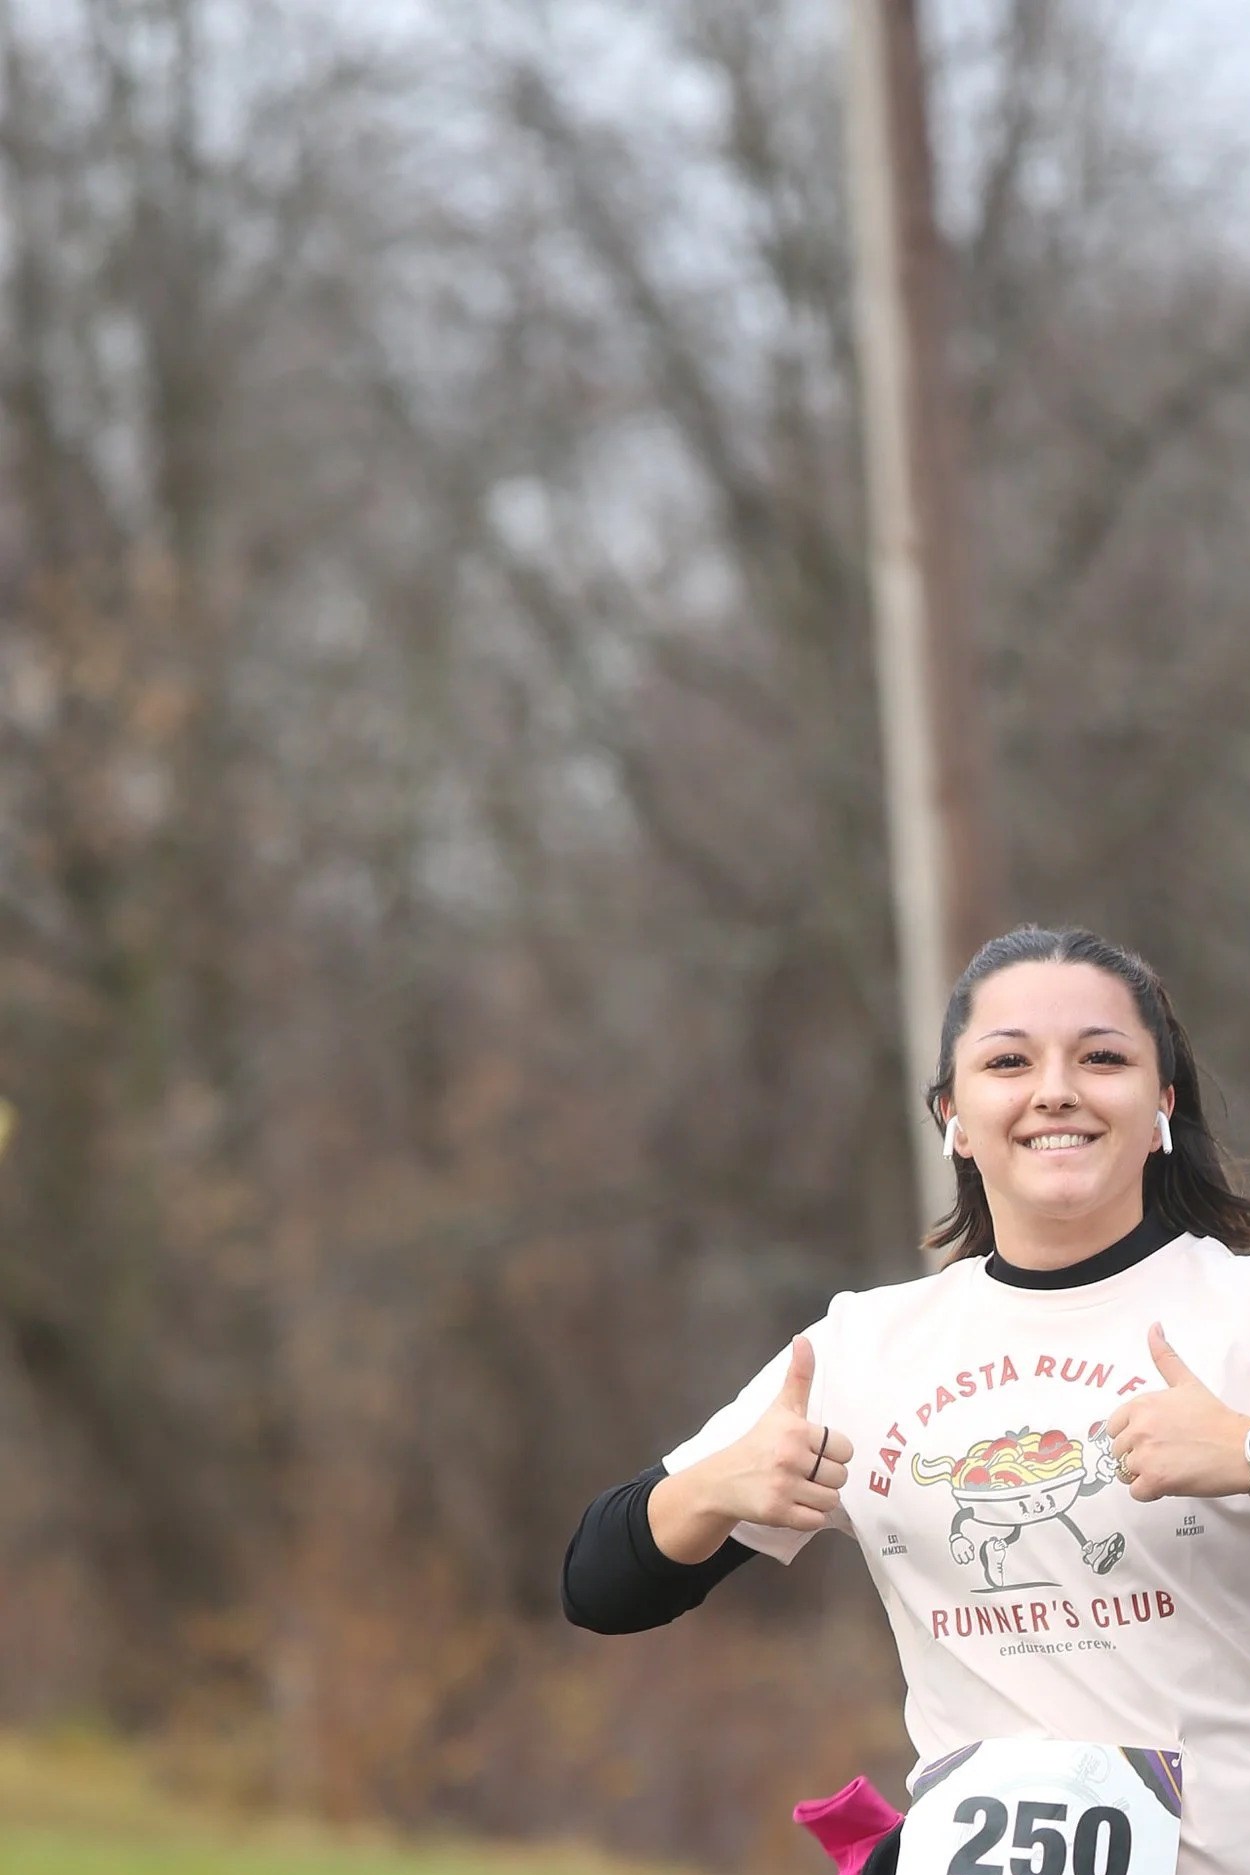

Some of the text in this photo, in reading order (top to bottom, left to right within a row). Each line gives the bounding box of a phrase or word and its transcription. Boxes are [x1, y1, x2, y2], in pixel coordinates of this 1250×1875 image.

[869, 1422, 908, 1497] EAT
[916, 1355, 1018, 1427] PASTA
[1034, 1354, 1114, 1388] RUN
[1183, 1515, 1197, 1525] EST
[931, 1590, 1176, 1638] RUNNER'S CLUB
[999, 1638, 1117, 1657] endurance crew.
